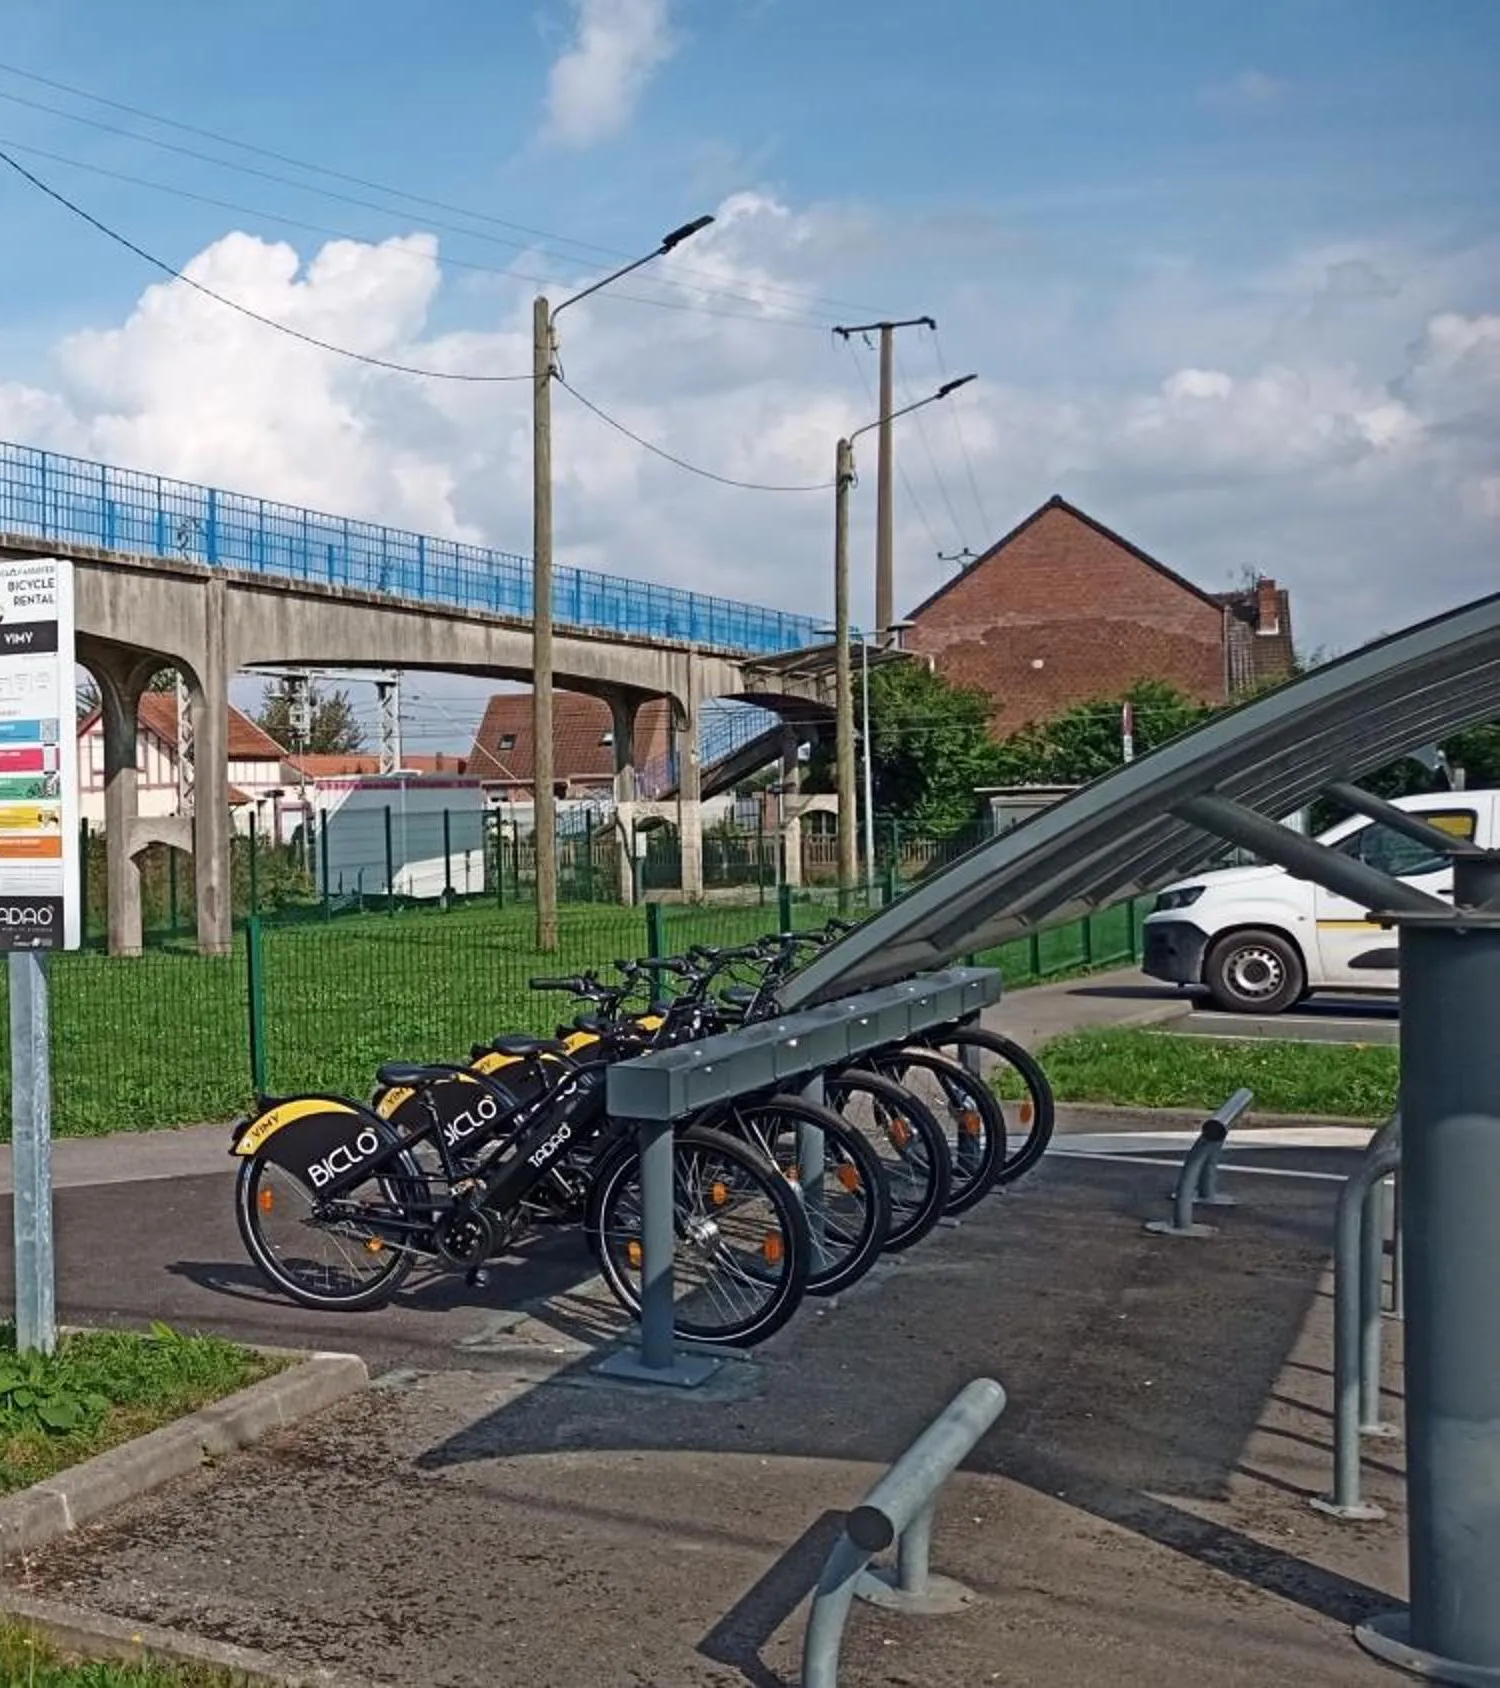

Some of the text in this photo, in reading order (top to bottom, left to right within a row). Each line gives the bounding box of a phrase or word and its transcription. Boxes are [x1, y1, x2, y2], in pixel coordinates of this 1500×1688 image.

[8, 577, 55, 592] BICYCLE
[13, 594, 54, 607] RENTAL
[3, 631, 34, 645] VIMY
[251, 1112, 280, 1138] VIMY
